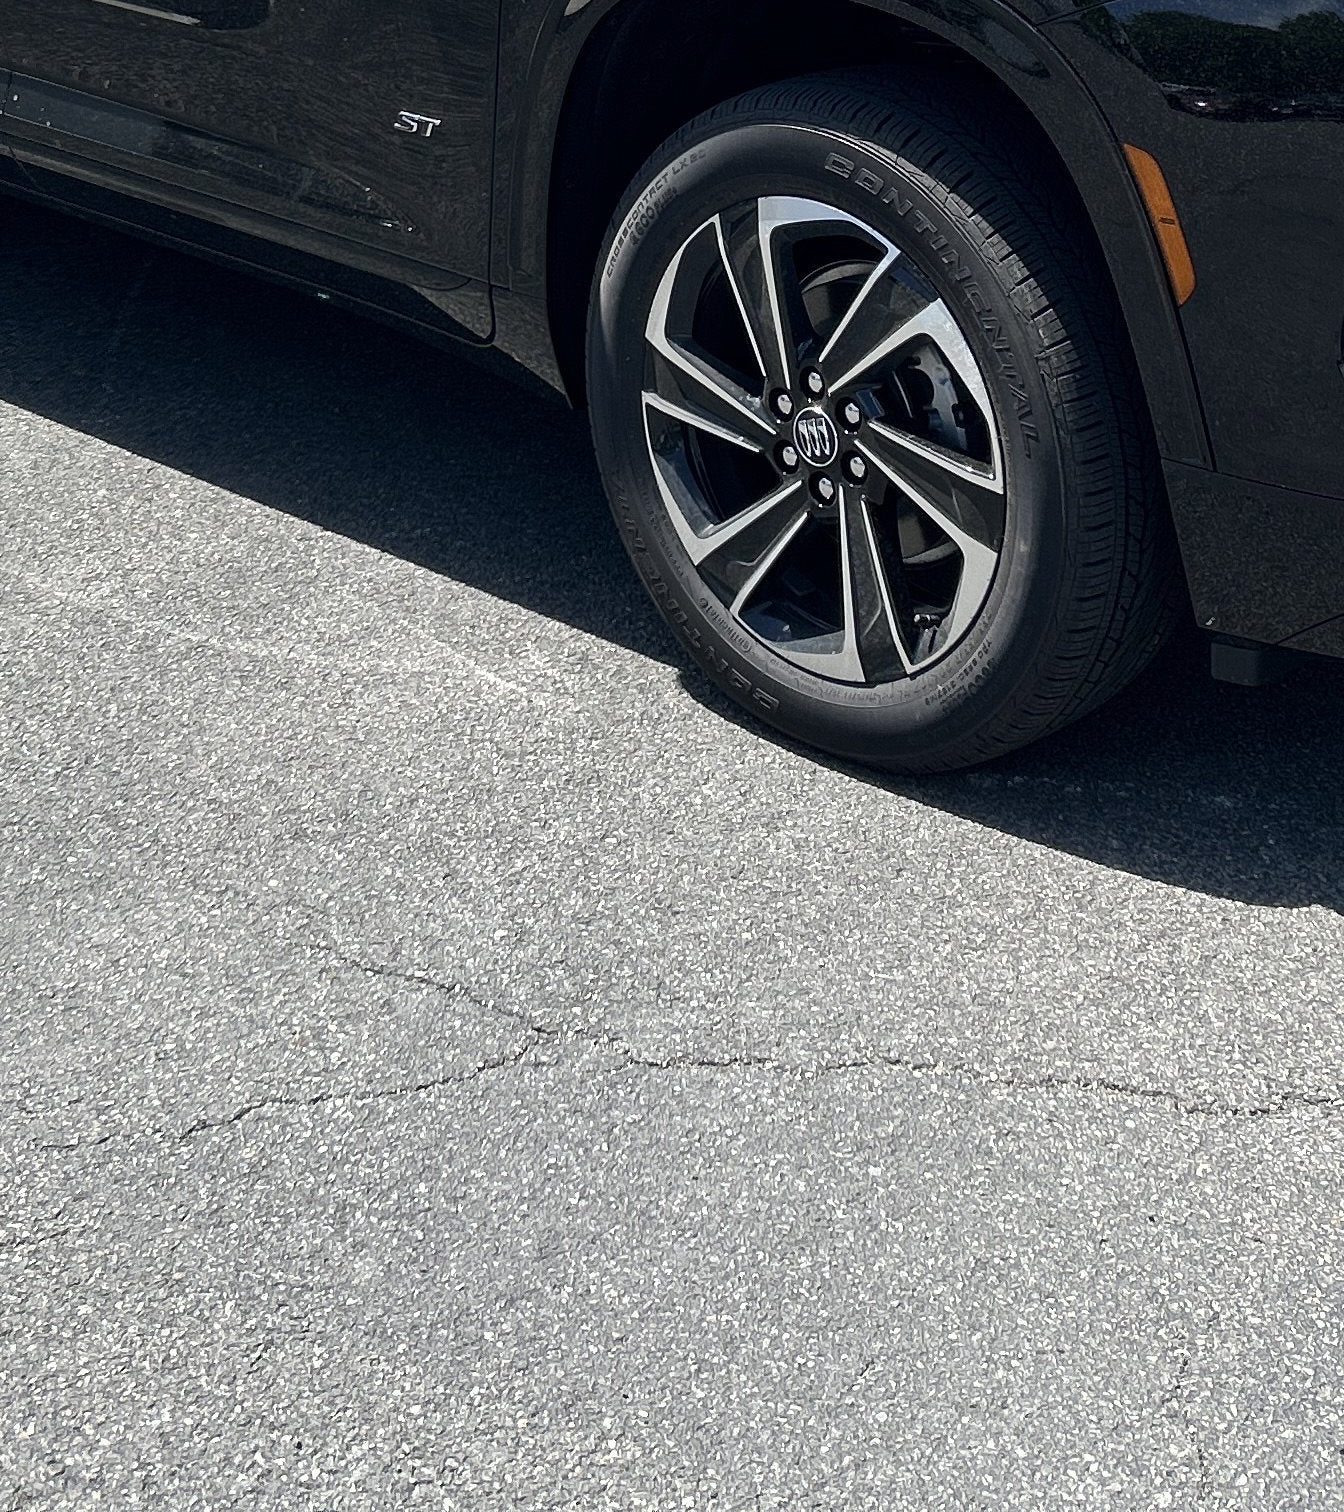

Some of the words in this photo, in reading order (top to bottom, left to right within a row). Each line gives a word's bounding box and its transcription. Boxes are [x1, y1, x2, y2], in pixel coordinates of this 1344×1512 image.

[394, 111, 441, 137] ST
[606, 173, 670, 279] CROSSCONTACT
[824, 152, 1040, 459] CONTINENTAL
